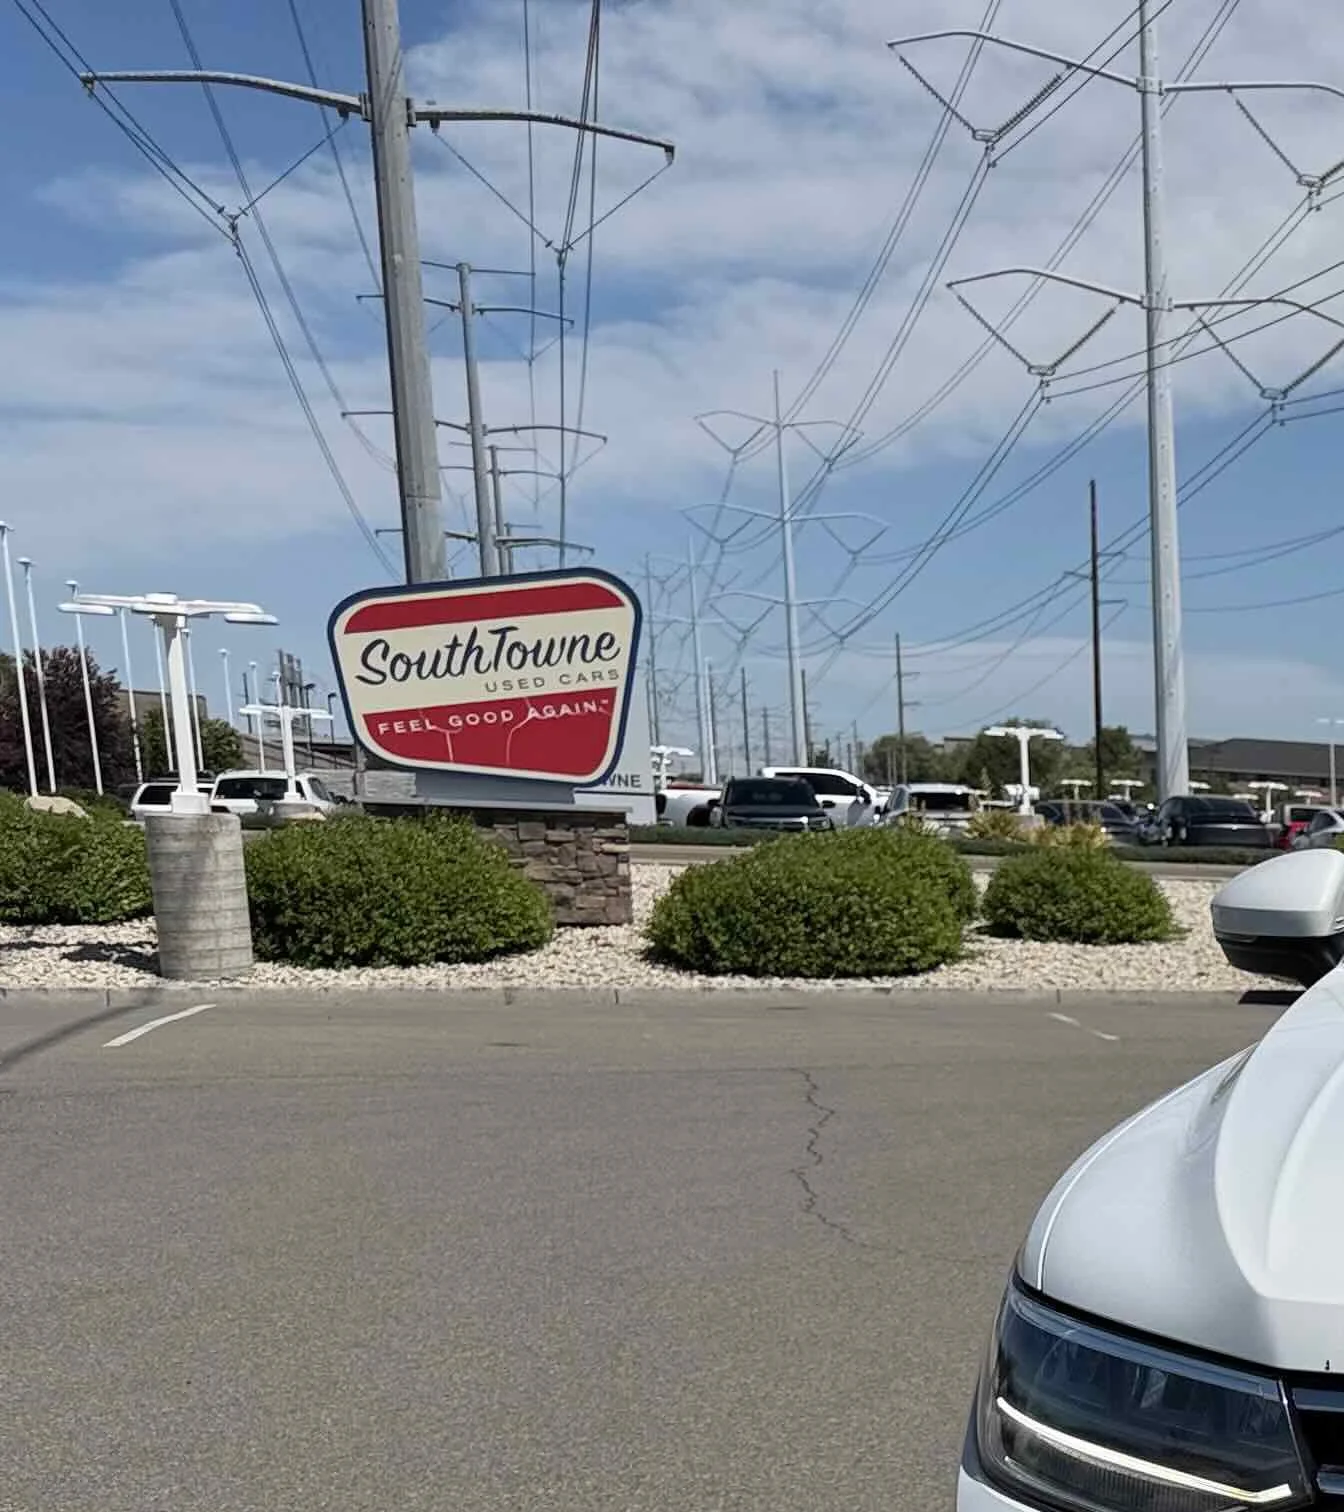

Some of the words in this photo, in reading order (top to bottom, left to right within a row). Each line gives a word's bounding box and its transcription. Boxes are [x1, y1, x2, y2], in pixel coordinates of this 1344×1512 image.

[355, 625, 621, 685] SouthTowne
[485, 676, 546, 693] USED
[558, 668, 620, 685] CARS
[378, 718, 436, 735] FEEL
[448, 710, 514, 727] GOOD
